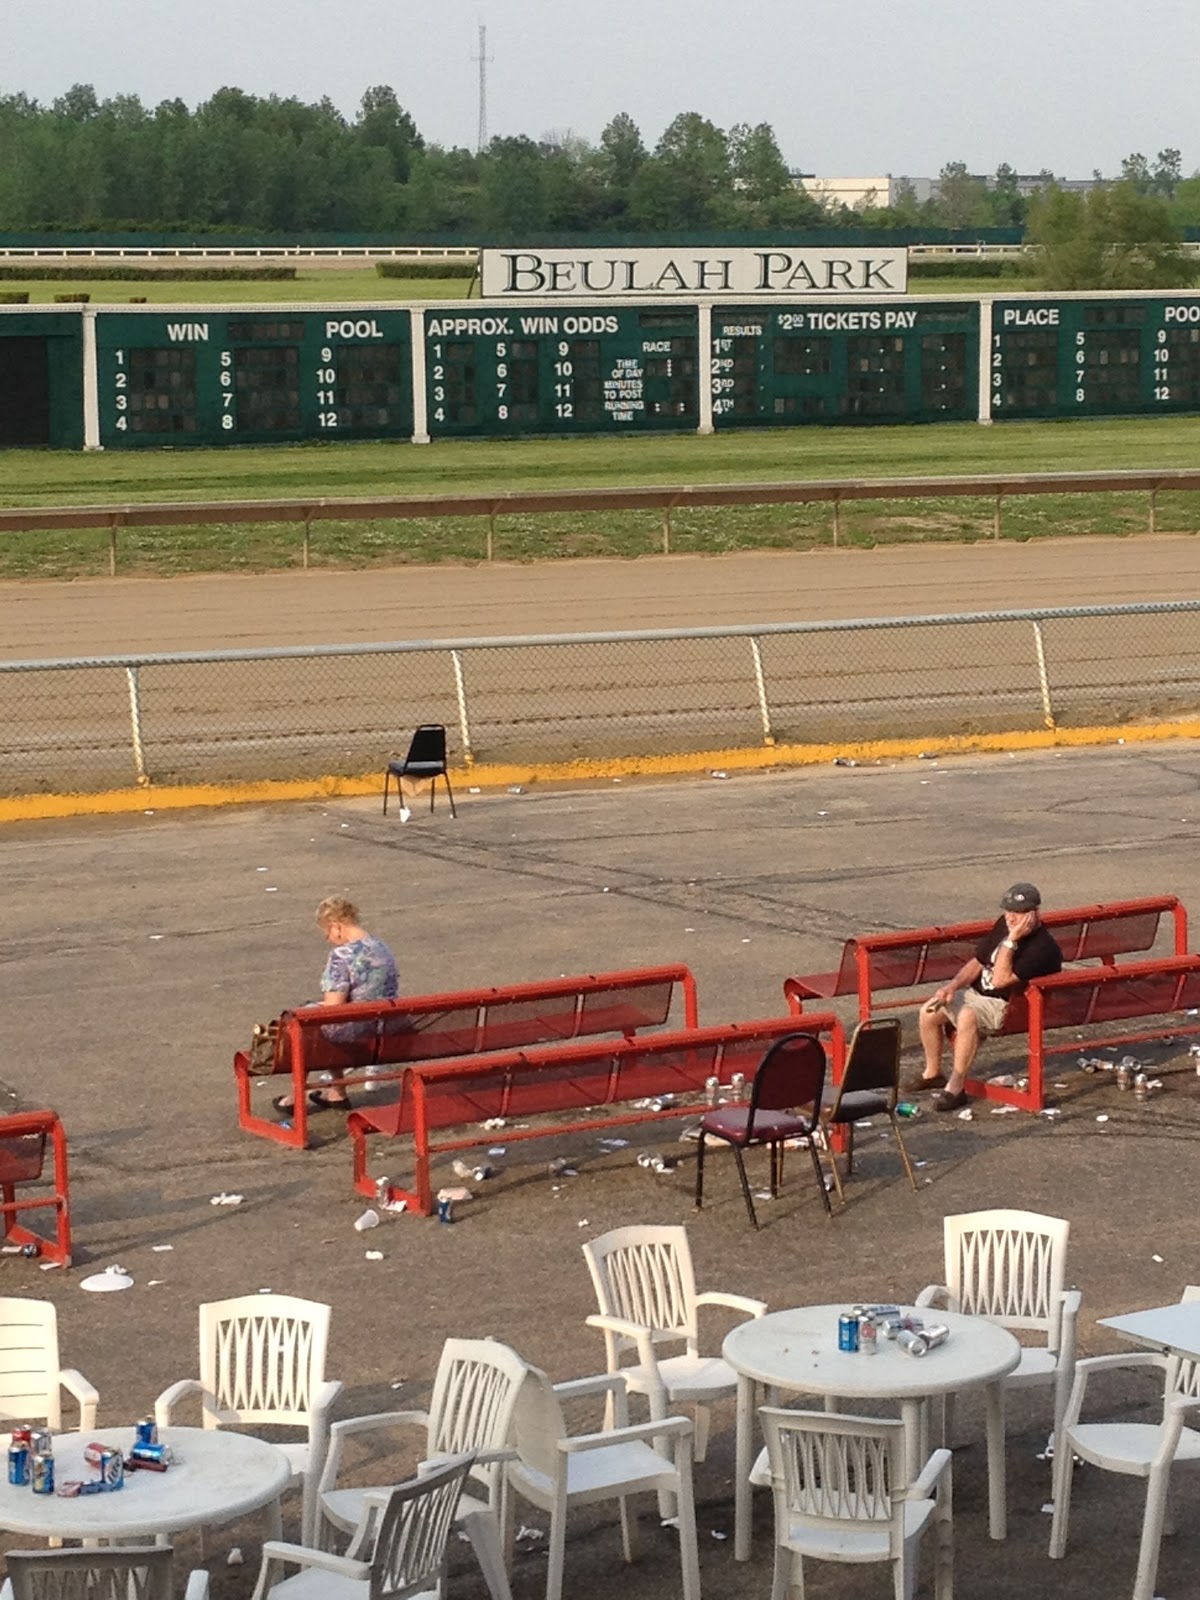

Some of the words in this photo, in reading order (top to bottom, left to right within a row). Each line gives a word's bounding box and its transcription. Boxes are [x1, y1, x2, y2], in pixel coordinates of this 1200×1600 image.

[501, 253, 735, 292] BEULAH
[754, 252, 895, 290] PARK
[807, 313, 882, 330] TICKETS
[885, 311, 917, 329] PAY
[1004, 309, 1059, 325] PLACE
[167, 323, 209, 341] WIN
[326, 320, 383, 338] POOL
[428, 318, 514, 336] APPROX.
[520, 317, 558, 334] WIN
[563, 315, 619, 333] ODDS
[723, 325, 763, 336] RESULTS
[994, 334, 1001, 347] 1
[1076, 332, 1085, 345] 5
[1157, 329, 1167, 343] 9
[434, 345, 442, 359] 1
[496, 343, 506, 357] 5
[558, 341, 569, 356] 9
[642, 341, 671, 352] RACE
[115, 350, 124, 365] 1
[220, 351, 231, 366] 5
[321, 347, 332, 363] 9
[993, 353, 1002, 367] 2
[1075, 351, 1085, 364] 6
[1154, 348, 1169, 362] 10
[496, 364, 507, 378] 6
[554, 362, 572, 376] 10
[616, 359, 638, 369] TIME
[220, 371, 231, 386] 6
[317, 370, 335, 384] 10
[434, 366, 444, 380] 2
[611, 369, 624, 379] OF
[626, 369, 644, 378] DAY
[993, 373, 1002, 387] 3
[1076, 370, 1085, 383] 7
[1154, 367, 1168, 381] 11
[115, 373, 127, 388] 2
[604, 380, 643, 389] MINUTES
[434, 386, 445, 401] 3
[497, 384, 507, 398] 7
[554, 383, 571, 397] 11
[604, 391, 617, 400] TO
[620, 389, 643, 399] POST
[1076, 388, 1085, 402] 8
[1154, 386, 1170, 400] 12
[115, 395, 127, 410] 3
[222, 392, 233, 407] 7
[317, 390, 334, 405] 11
[992, 394, 1002, 406] 4
[498, 405, 508, 420] 8
[555, 403, 573, 418] 12
[604, 400, 644, 411] RUNNING
[318, 412, 337, 427] 12
[435, 407, 445, 421] 4
[612, 411, 634, 421] TIME
[115, 416, 127, 432] 4
[221, 414, 233, 430] 8
